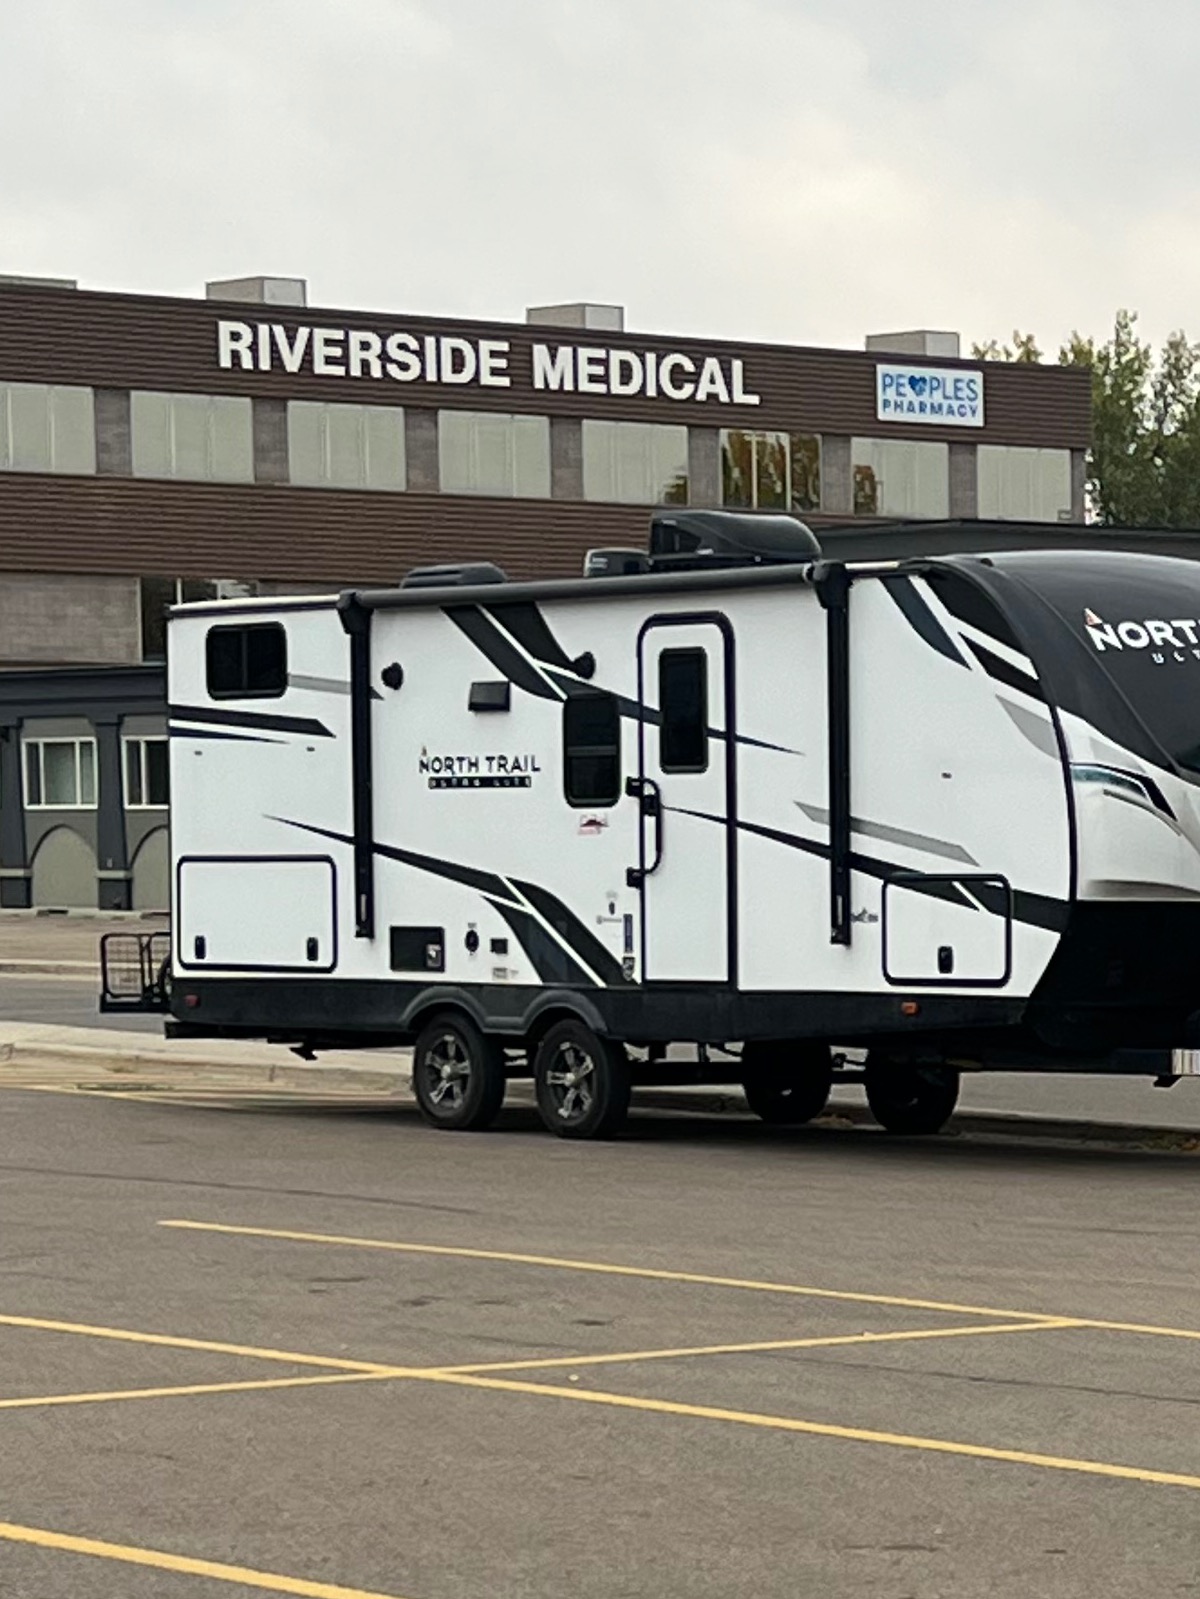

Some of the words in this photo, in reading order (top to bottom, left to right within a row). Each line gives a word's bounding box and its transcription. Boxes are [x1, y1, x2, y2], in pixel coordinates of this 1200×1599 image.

[217, 320, 511, 387] RIVERSIDE
[532, 344, 761, 405] MEDICAL
[883, 398, 979, 418] PHARMACY
[418, 755, 480, 775] NORTH
[485, 754, 542, 775] TRAIL
